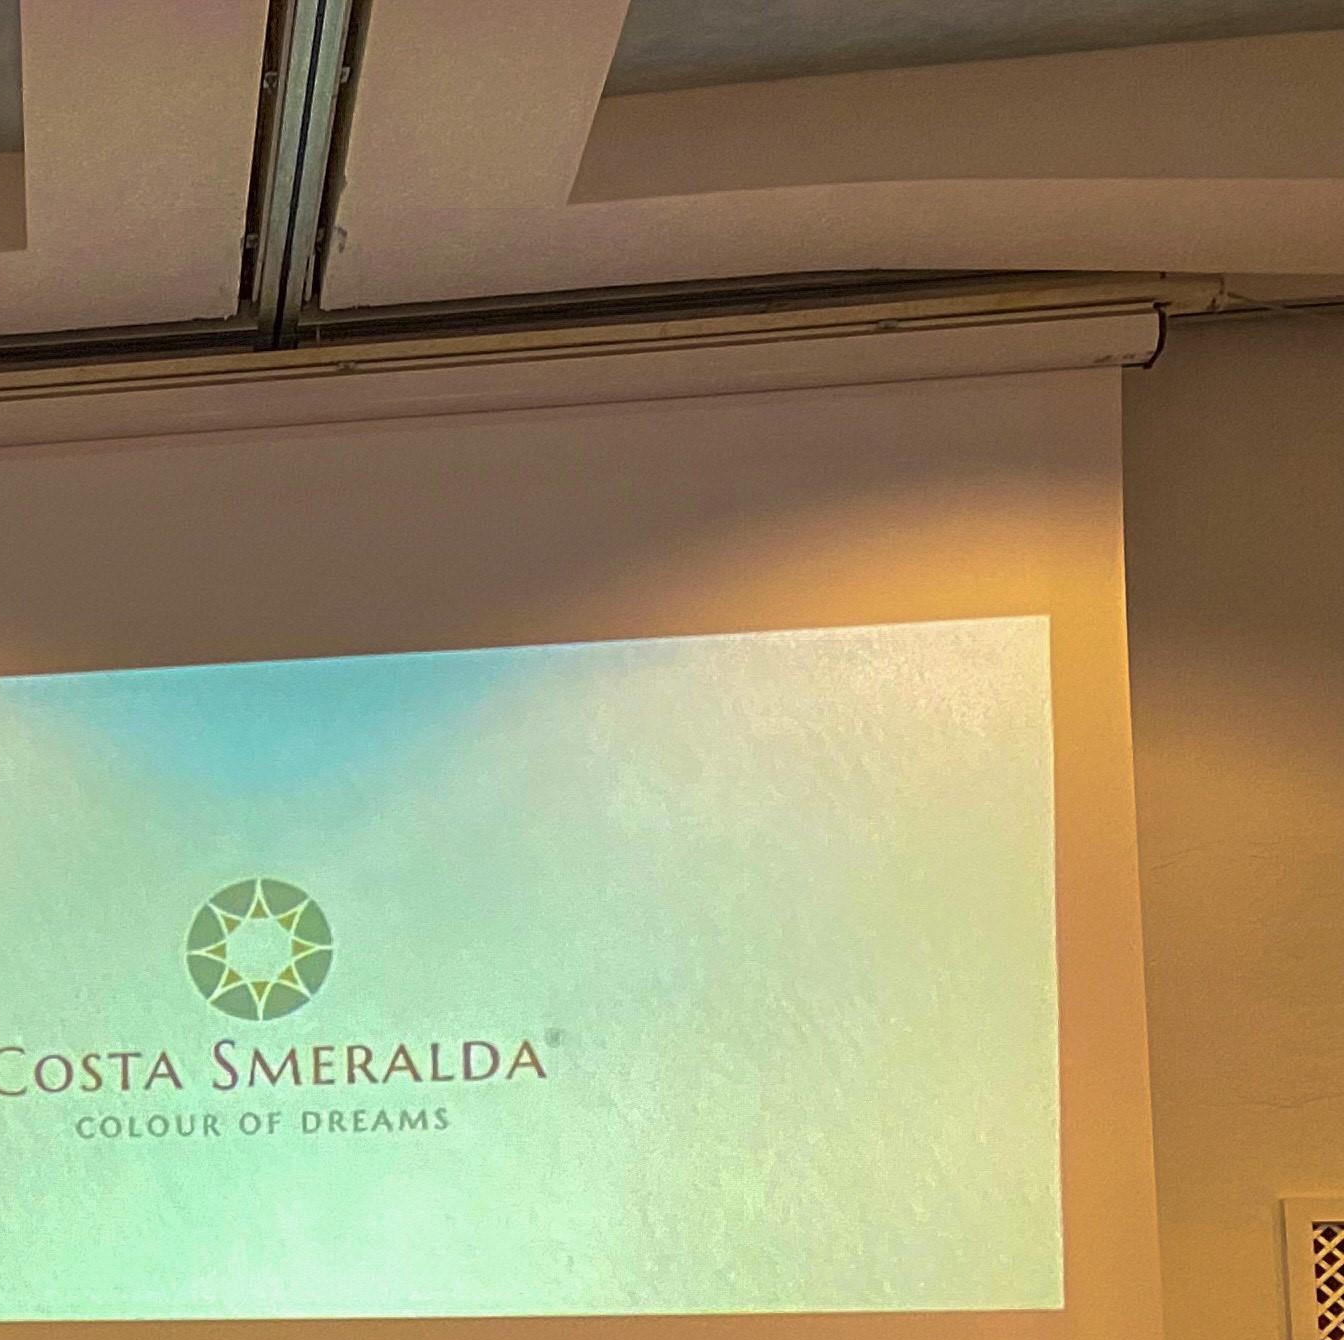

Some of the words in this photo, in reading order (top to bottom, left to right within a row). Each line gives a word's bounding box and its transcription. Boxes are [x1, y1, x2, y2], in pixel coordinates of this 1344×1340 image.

[211, 1038, 548, 1092] SMERALDA
[74, 1113, 222, 1140] COLOUR
[238, 1110, 282, 1136] OF
[301, 1106, 451, 1135] DREAMS
